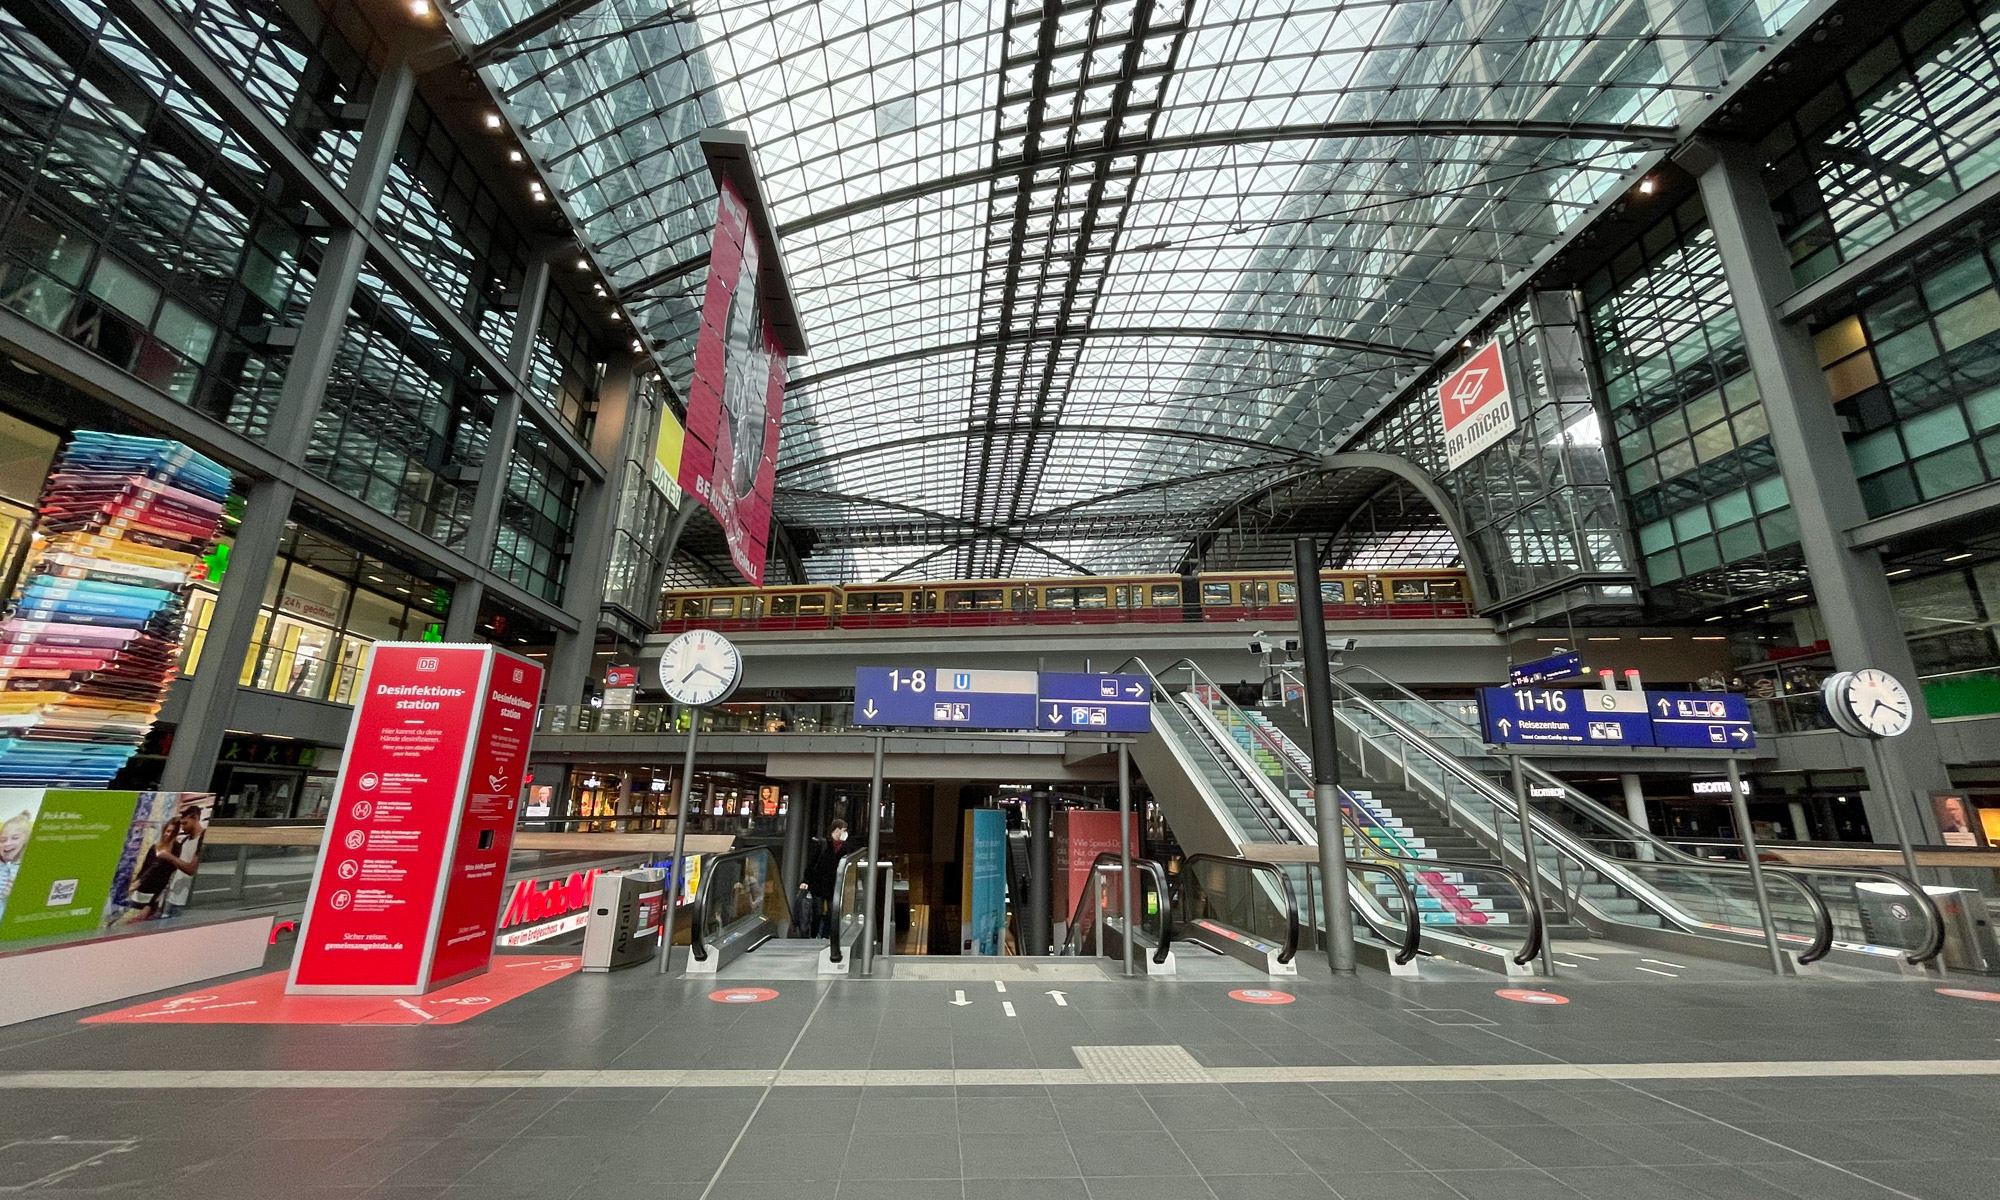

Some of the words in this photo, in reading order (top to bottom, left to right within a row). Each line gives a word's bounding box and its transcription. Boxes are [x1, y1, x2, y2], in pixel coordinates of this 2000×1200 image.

[652, 461, 681, 510] DATEV
[304, 604, 336, 620] geöffnet
[418, 659, 437, 670] DB
[888, 669, 926, 693] 1-8
[956, 674, 969, 690] U
[377, 684, 465, 697] Desinfektions-
[1102, 686, 1115, 696] WC
[396, 700, 440, 710] station
[492, 690, 532, 710] Desinfektions-
[1514, 690, 1567, 712] 11-16
[1604, 696, 1614, 709] S
[500, 708, 521, 720] station
[1518, 720, 1570, 730] Reisezentrum
[1712, 733, 1724, 741] WC
[1074, 838, 1088, 847] Wie
[528, 922, 558, 941] Erdgeschoss
[617, 904, 631, 954] Abfall
[324, 942, 404, 950] gemeinsamgehtdas.de
